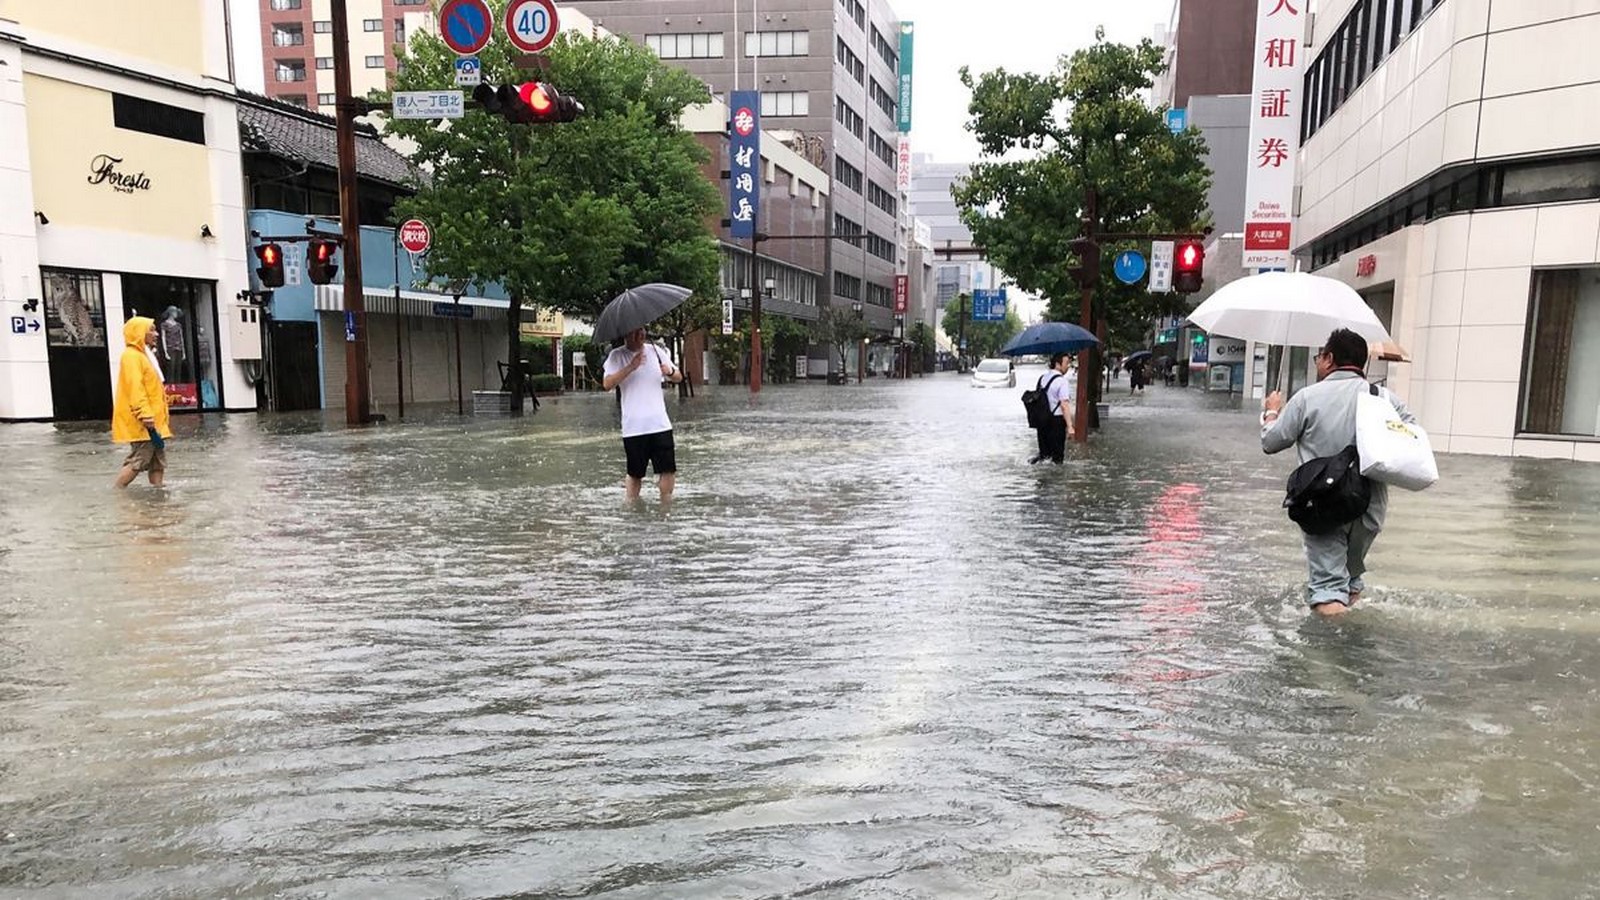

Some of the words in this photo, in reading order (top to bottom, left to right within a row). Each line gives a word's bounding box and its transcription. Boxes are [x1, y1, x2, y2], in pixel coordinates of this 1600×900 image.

[518, 10, 546, 35] 40
[397, 95, 460, 107] 唐人一丁目北
[87, 153, 151, 191] Foresta
[1258, 201, 1281, 210] Daiwa
[1251, 210, 1287, 219] Securities
[403, 229, 427, 243] 消火栓
